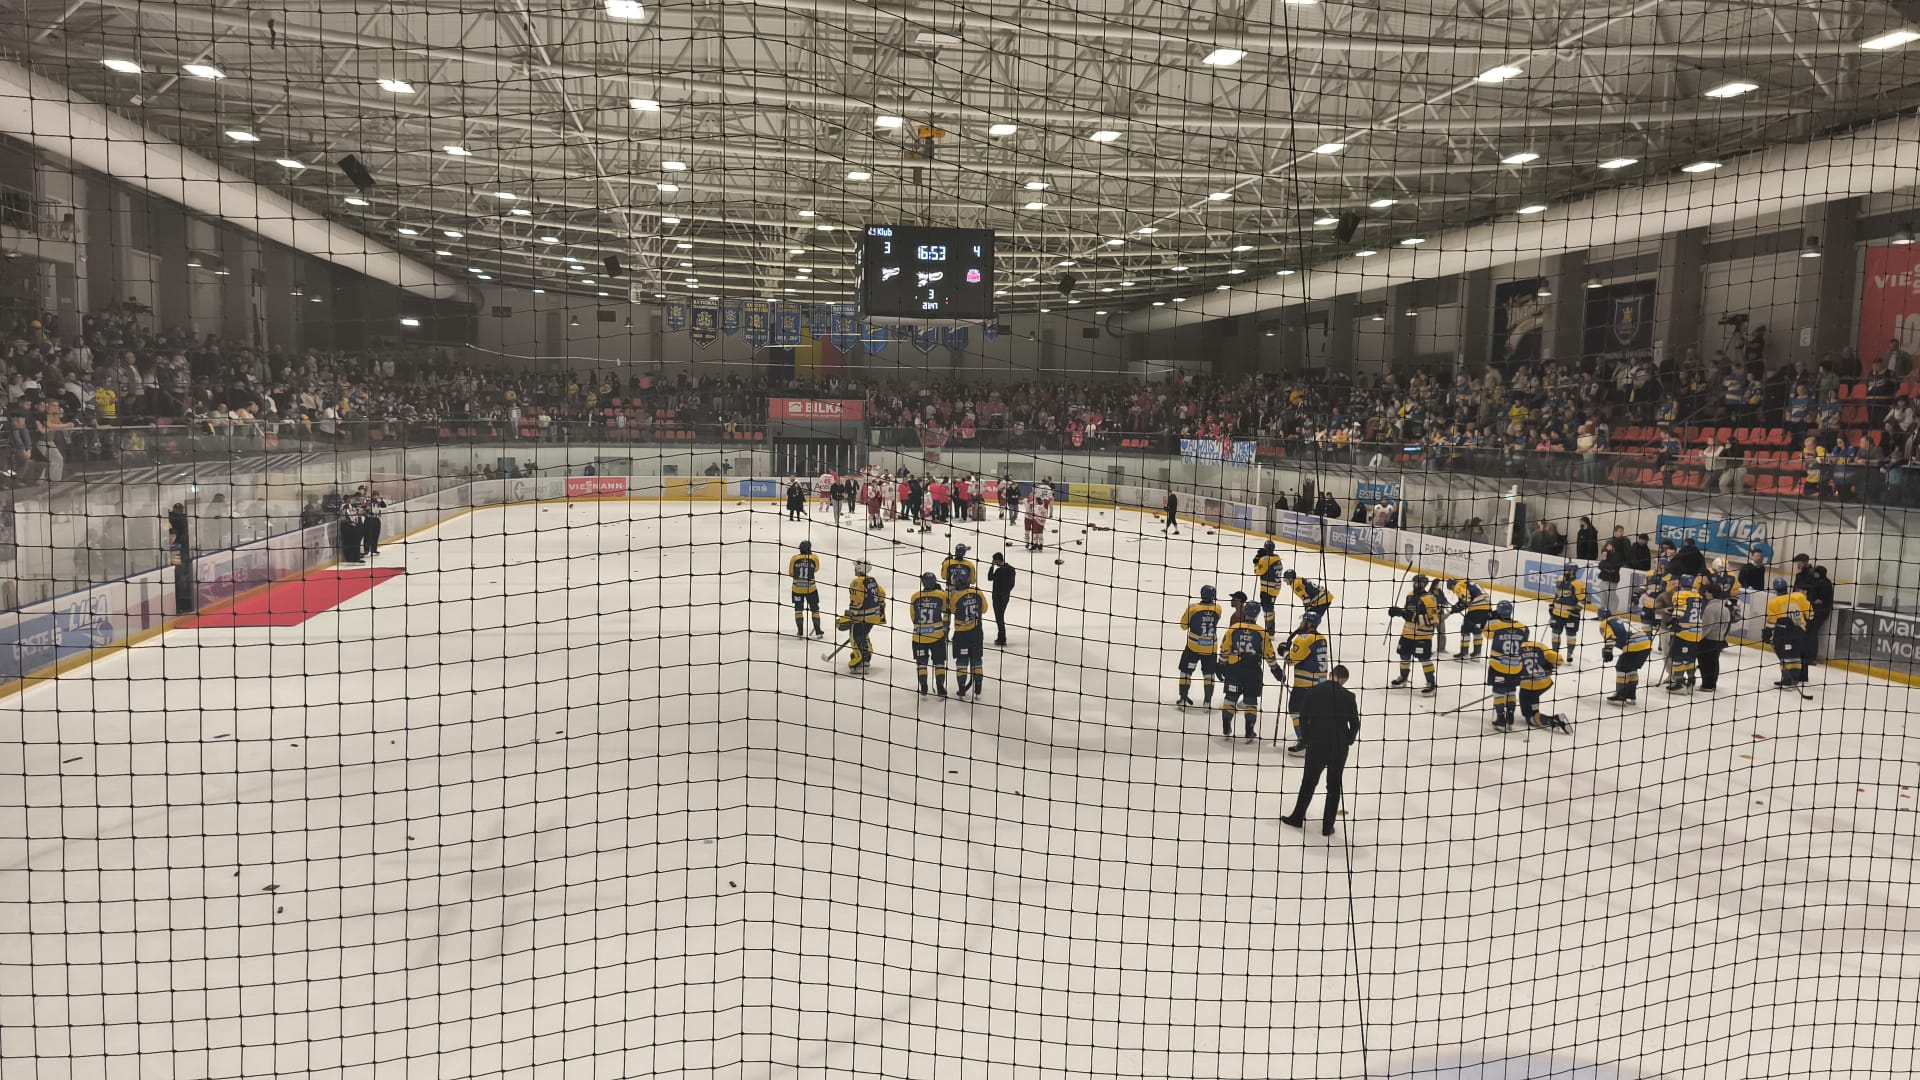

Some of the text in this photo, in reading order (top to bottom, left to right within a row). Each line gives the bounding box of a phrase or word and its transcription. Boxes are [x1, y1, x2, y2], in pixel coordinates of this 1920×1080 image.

[877, 228, 893, 237] Klub
[884, 242, 891, 254] 3
[917, 245, 946, 261] 16:53
[973, 245, 981, 258] 4
[928, 289, 935, 300] 3
[806, 402, 842, 414] BILKA
[1384, 484, 1400, 498] LIG
[1359, 527, 1383, 545] LIGA
[1661, 520, 1768, 541] ERSTE LIGA
[1528, 570, 1557, 586] ERSTE
